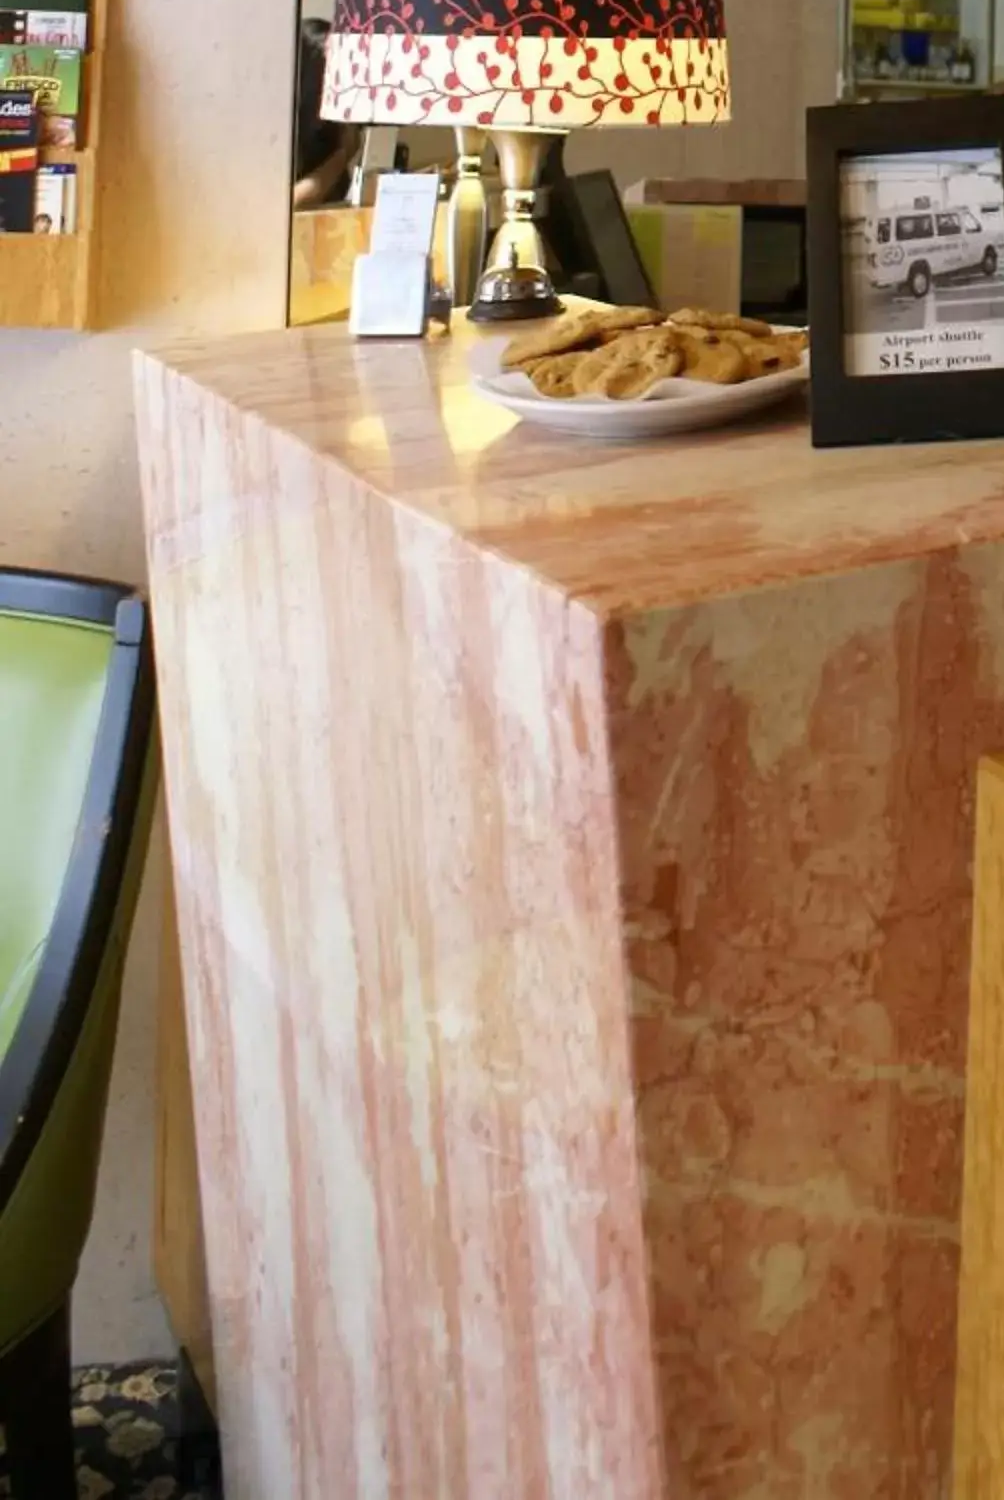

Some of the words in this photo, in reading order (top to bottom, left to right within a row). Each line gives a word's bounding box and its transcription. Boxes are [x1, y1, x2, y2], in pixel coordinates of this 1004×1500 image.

[883, 334, 935, 348] Airport
[939, 330, 985, 343] shuttle
[880, 351, 914, 370] $15
[919, 357, 940, 369] per
[946, 354, 992, 369] person
